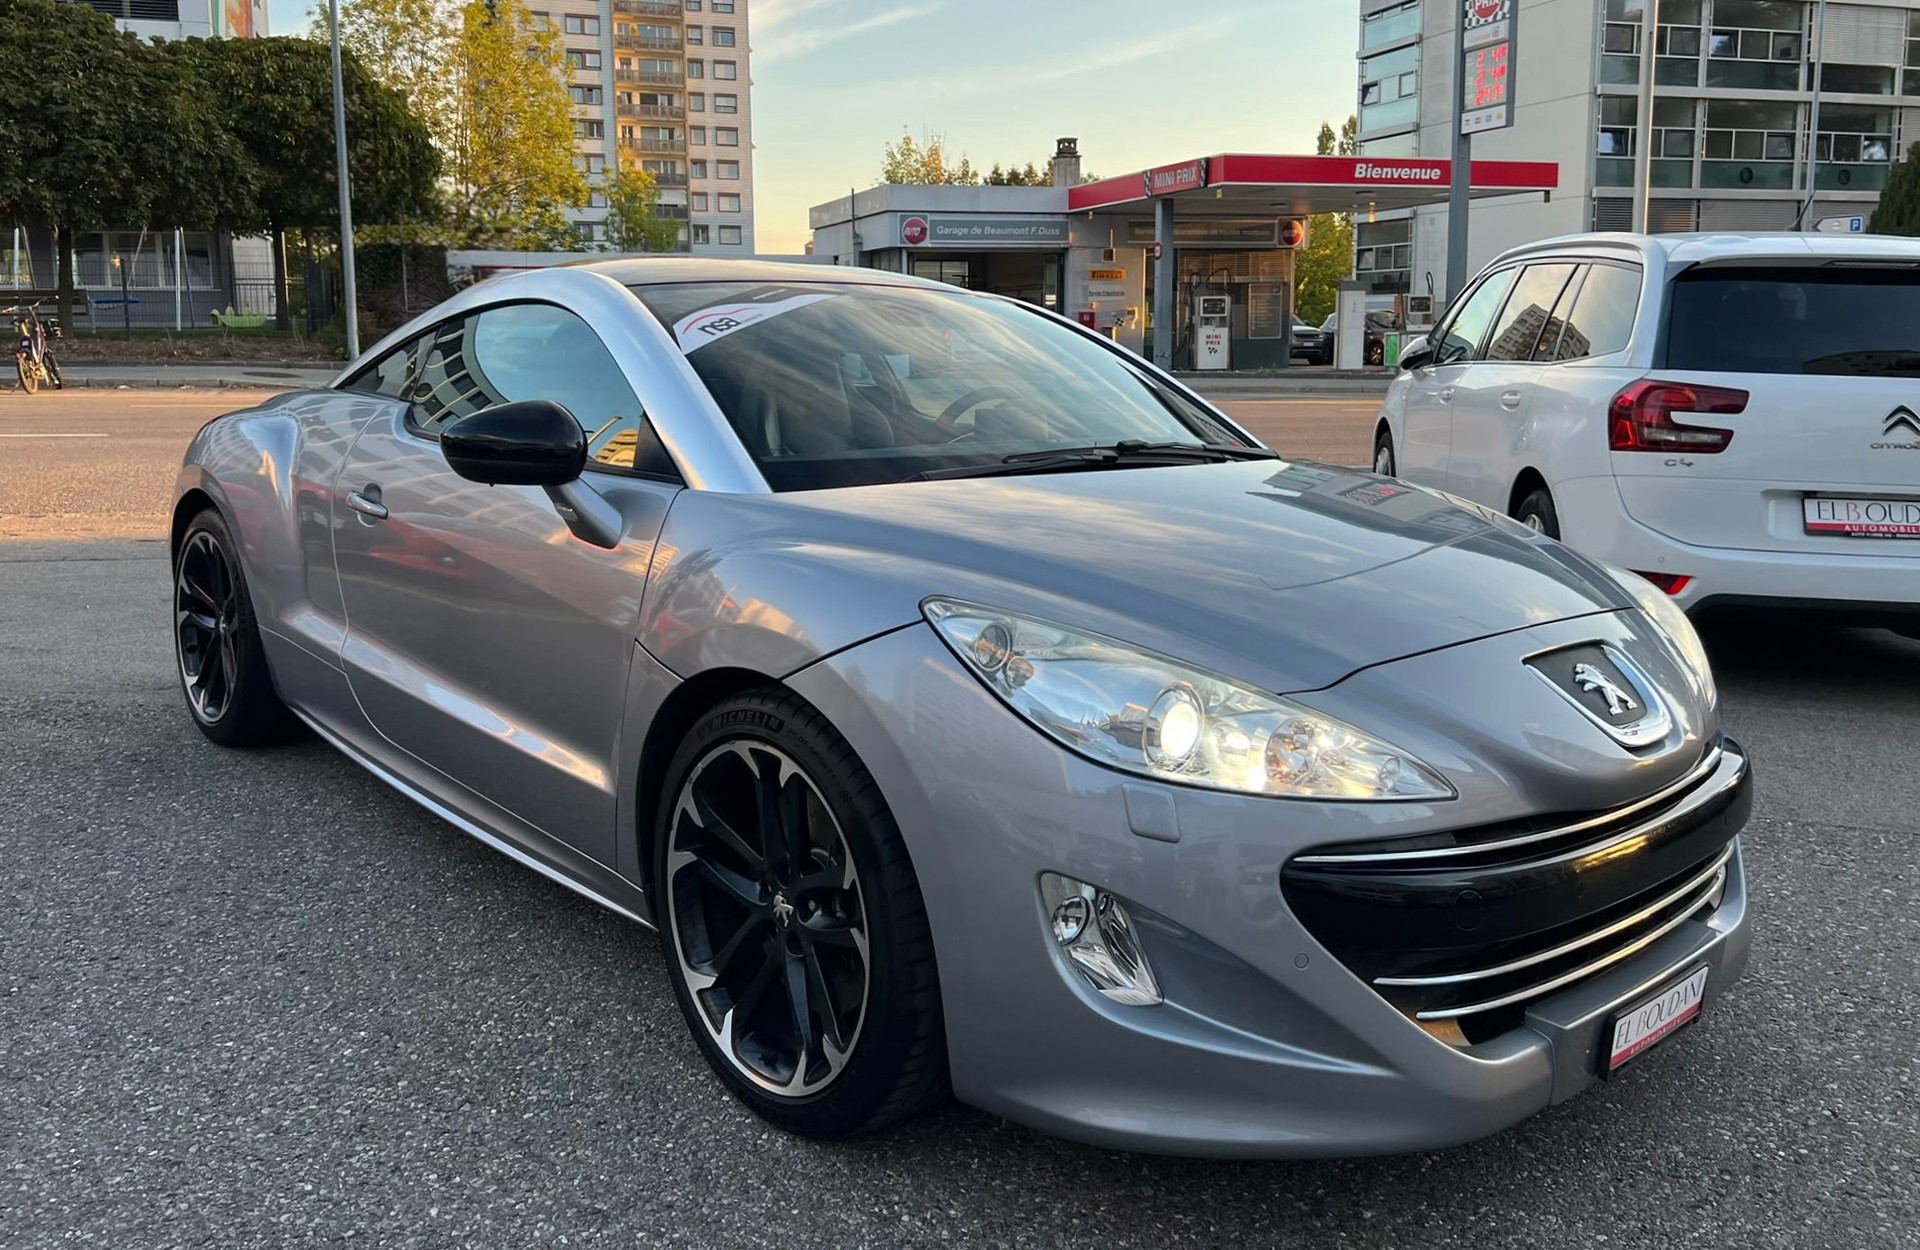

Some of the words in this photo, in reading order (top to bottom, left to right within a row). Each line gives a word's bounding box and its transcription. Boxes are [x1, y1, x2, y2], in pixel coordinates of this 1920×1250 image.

[1154, 170, 1174, 188] MINI
[1176, 166, 1197, 184] PRIX
[1354, 163, 1441, 180] Bienvenue
[936, 225, 968, 236] Garage
[970, 225, 982, 235] de
[984, 225, 1029, 235] Beaumont
[1091, 270, 1122, 279] PIRELLI
[698, 317, 742, 336] nsa
[1843, 524, 1920, 534] AUTOMOBIL
[711, 709, 780, 730] MICHELIN
[1615, 1020, 1631, 1049] EL
[1636, 974, 1704, 1036] BOUDAN
